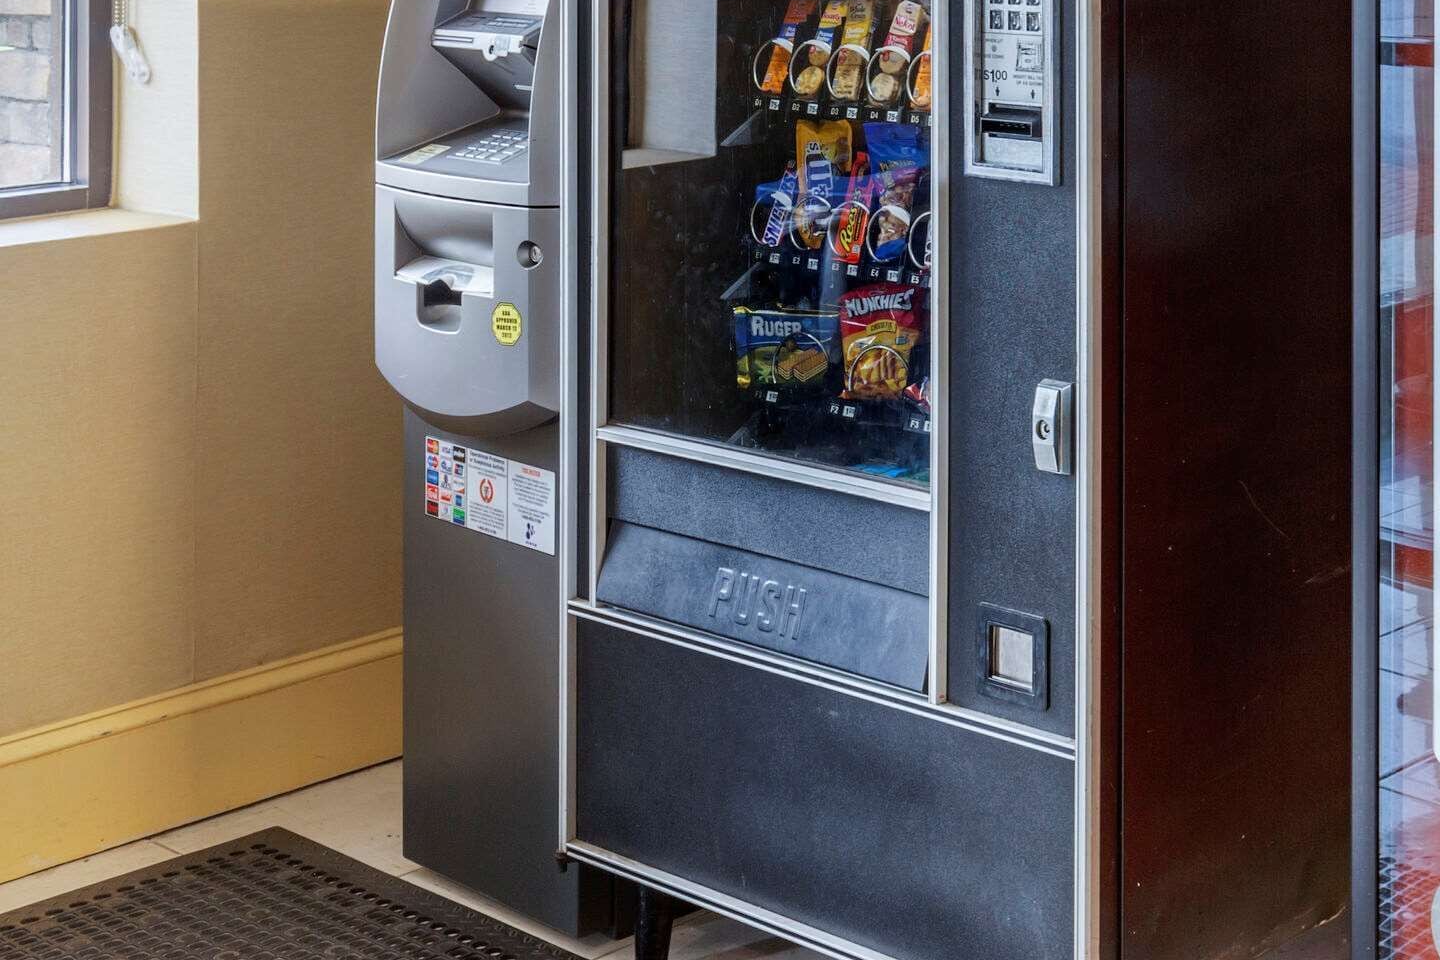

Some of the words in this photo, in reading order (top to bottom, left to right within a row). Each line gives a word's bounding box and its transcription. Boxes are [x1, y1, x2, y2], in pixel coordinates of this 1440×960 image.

[792, 103, 800, 111] D2
[831, 107, 839, 115] D3
[911, 115, 919, 123] D5
[870, 269, 879, 277] E4
[845, 289, 915, 318] MUNCHIES
[752, 316, 801, 336] RUGER
[830, 405, 839, 413] F2
[910, 420, 919, 428] F3
[708, 567, 807, 640] PUSH
